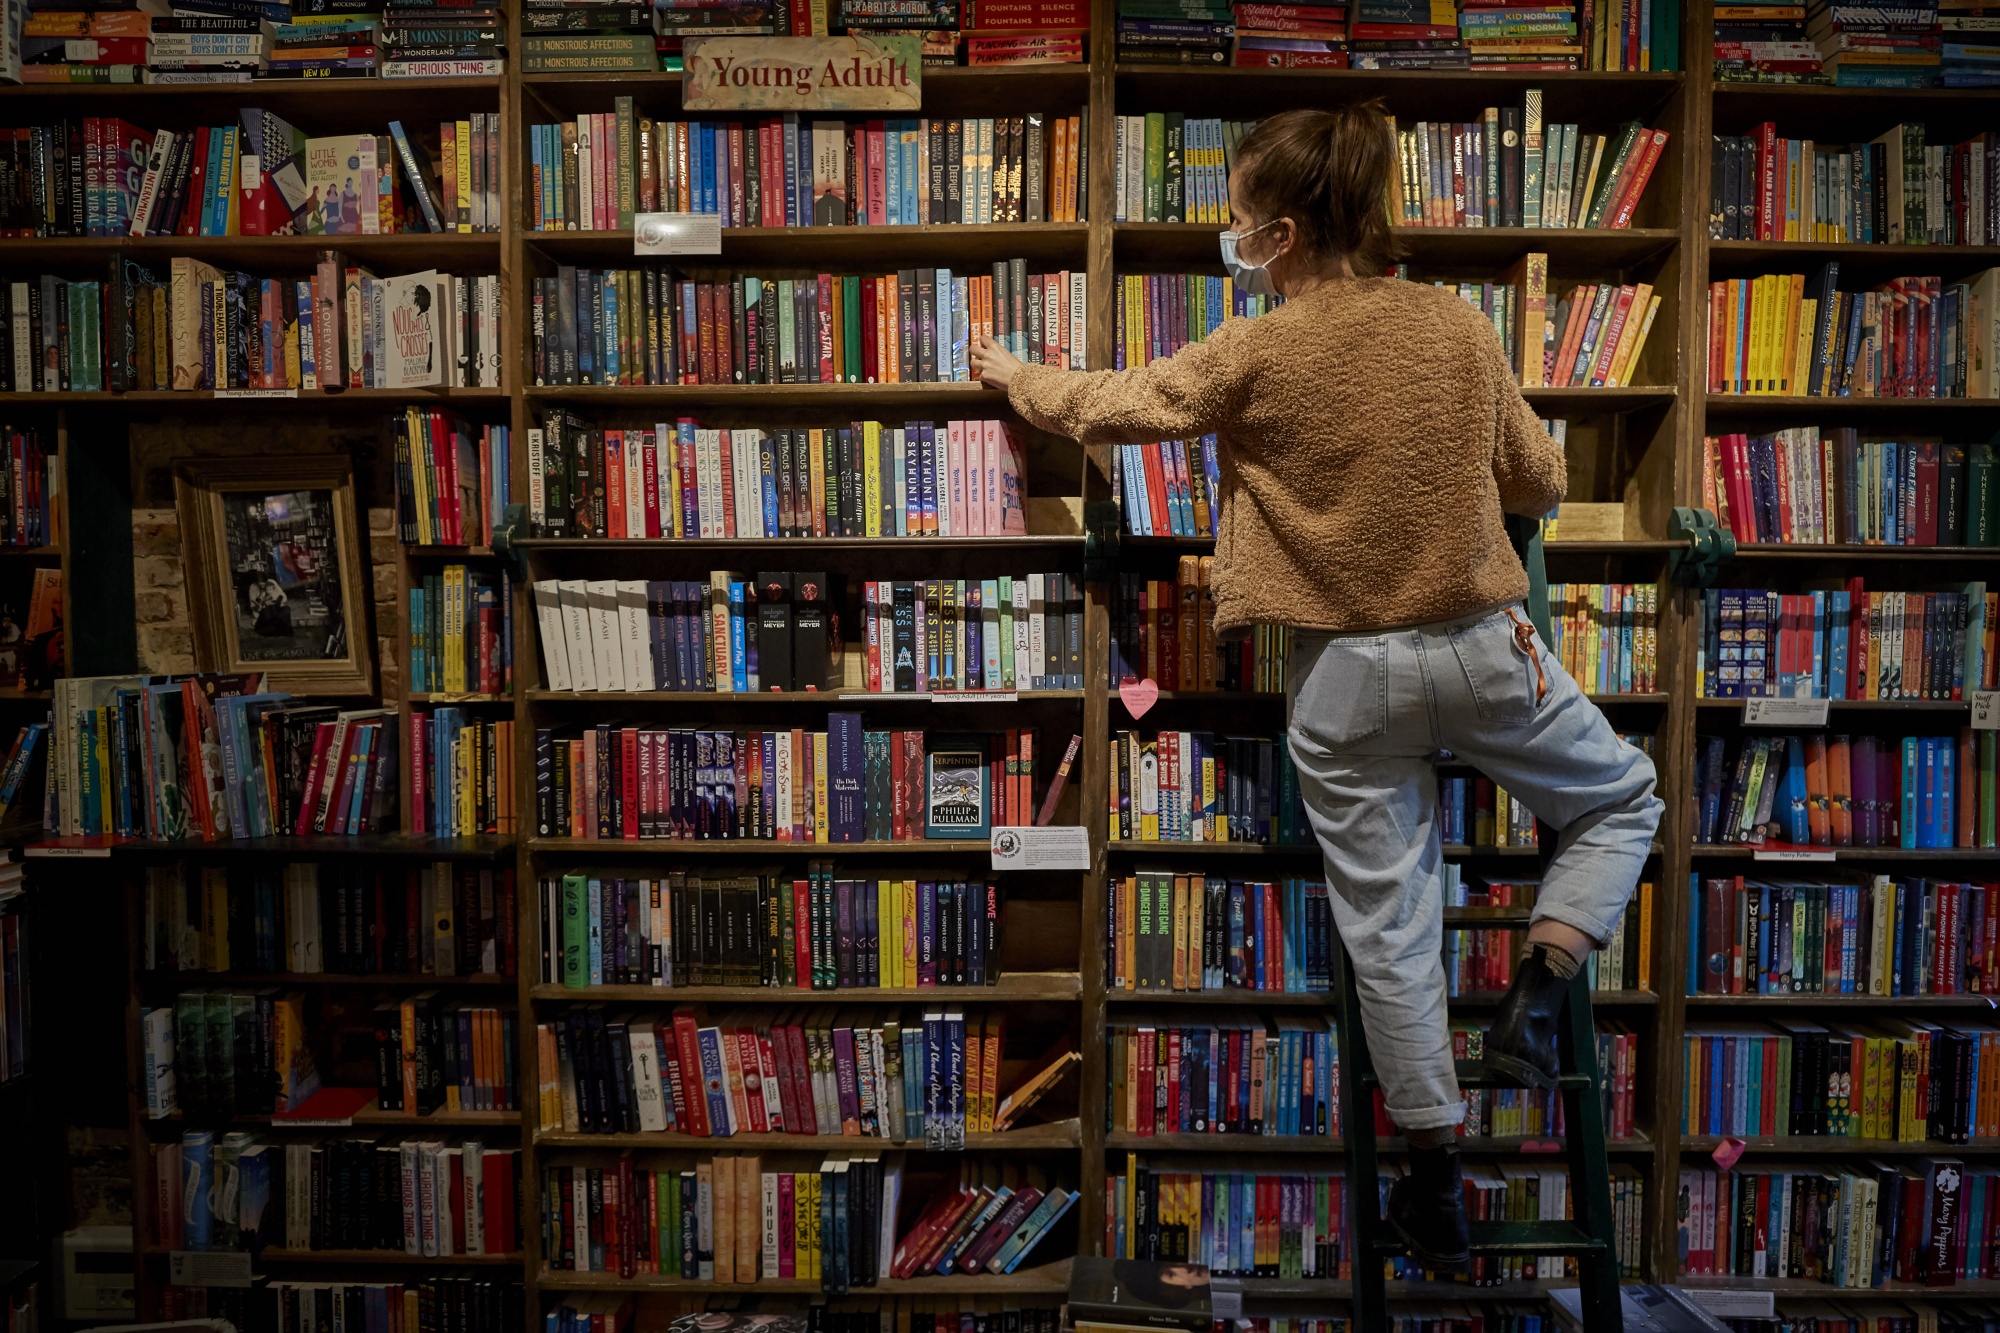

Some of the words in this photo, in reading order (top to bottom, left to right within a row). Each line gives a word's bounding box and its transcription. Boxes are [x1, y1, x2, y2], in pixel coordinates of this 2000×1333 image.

[985, 4, 1032, 12] FOUNTAINS
[1524, 12, 1562, 20] NORMAL
[180, 19, 198, 29] THE
[201, 19, 248, 29] BEAUTIFUL
[410, 30, 479, 43] MONSTERS
[1511, 24, 1526, 32] KID
[1528, 23, 1568, 32] NORMAL
[157, 47, 186, 55] blackman
[192, 46, 210, 54] BOYS
[212, 45, 233, 53] DON'T
[235, 44, 249, 53] CRY
[190, 35, 210, 44] BOYS
[212, 35, 234, 44] DON'T
[236, 35, 250, 44] CRY
[544, 41, 588, 50] MONSTROUS
[591, 40, 633, 49] AFFECTIONS
[408, 64, 450, 75] FURIOUS
[453, 62, 483, 74] THING
[544, 58, 588, 67] MONSTROUS
[591, 57, 633, 66] AFFECTIONS
[712, 56, 813, 96] Young
[820, 57, 911, 88] Adult
[224, 131, 233, 144] YES
[458, 128, 468, 150] HERE
[620, 120, 629, 166] MONSTROUS
[887, 132, 896, 148] Why
[1488, 130, 1496, 161] WATER
[72, 155, 80, 172] THE
[86, 143, 96, 165] GIRL
[106, 144, 115, 165] GIRL
[223, 146, 231, 157] NO
[310, 149, 336, 158] LITTLE
[310, 159, 337, 168] WOMEN
[444, 141, 452, 174] NEXUS
[888, 150, 896, 164] We
[1767, 155, 1772, 168] ME
[87, 168, 97, 193] GONE
[106, 168, 116, 194] GONE
[219, 159, 230, 184] MAYBE
[459, 159, 468, 191] STAND
[888, 168, 898, 191] Broke
[1488, 164, 1496, 195] BEARS
[73, 176, 82, 225] BEAUTIFUL
[136, 172, 156, 223] INTERNMENT
[218, 186, 227, 197] SO
[621, 168, 630, 212] AFFECTIONS
[886, 194, 897, 207] Up
[1172, 177, 1180, 206] Watership
[88, 196, 99, 223] VIRAL
[107, 196, 117, 224] VIRAL
[593, 294, 601, 333] MERMAID
[1048, 284, 1058, 344] ILLUMINAE
[1074, 283, 1083, 320] KRISTOFF
[216, 288, 225, 344] TROUBLEMAKERS
[323, 308, 331, 343] LOVELY
[766, 292, 776, 345] RAYBEARER
[822, 336, 830, 359] STAIR
[1074, 322, 1082, 352] DEVIAT3
[324, 345, 332, 372] WAR
[532, 439, 540, 476] KRISTOFF
[761, 452, 770, 475] ONE
[781, 435, 789, 469] PITTACUS
[798, 435, 806, 469] PITTACUS
[828, 461, 833, 470] LU
[800, 472, 808, 492] LORE
[907, 441, 917, 519] SKYHUNTER
[922, 441, 932, 519] SKYHUNTER
[1907, 479, 1916, 507] EARTH
[533, 479, 541, 508] DEVIAT3
[826, 476, 837, 516] WILDCARD
[928, 585, 938, 625] NESS
[944, 586, 954, 625] NESS
[715, 614, 726, 675] SANCTUARY
[641, 746, 649, 775] ANNA
[934, 757, 978, 765] SERPENTINE
[933, 814, 978, 823] PULLMAN
[940, 806, 972, 815] PHILIP
[988, 886, 996, 918] NERVE
[1140, 889, 1151, 914] DANGER
[1158, 889, 1169, 915] DANGER
[1140, 916, 1151, 934] GANG
[1159, 916, 1169, 934] GANG
[403, 1169, 412, 1207] FURIOUS
[423, 1172, 432, 1209] FURIOUS
[1939, 1194, 1954, 1223] Mary
[406, 1212, 414, 1237] THING
[424, 1215, 433, 1240] THING
[1934, 1226, 1953, 1269] Poppins
